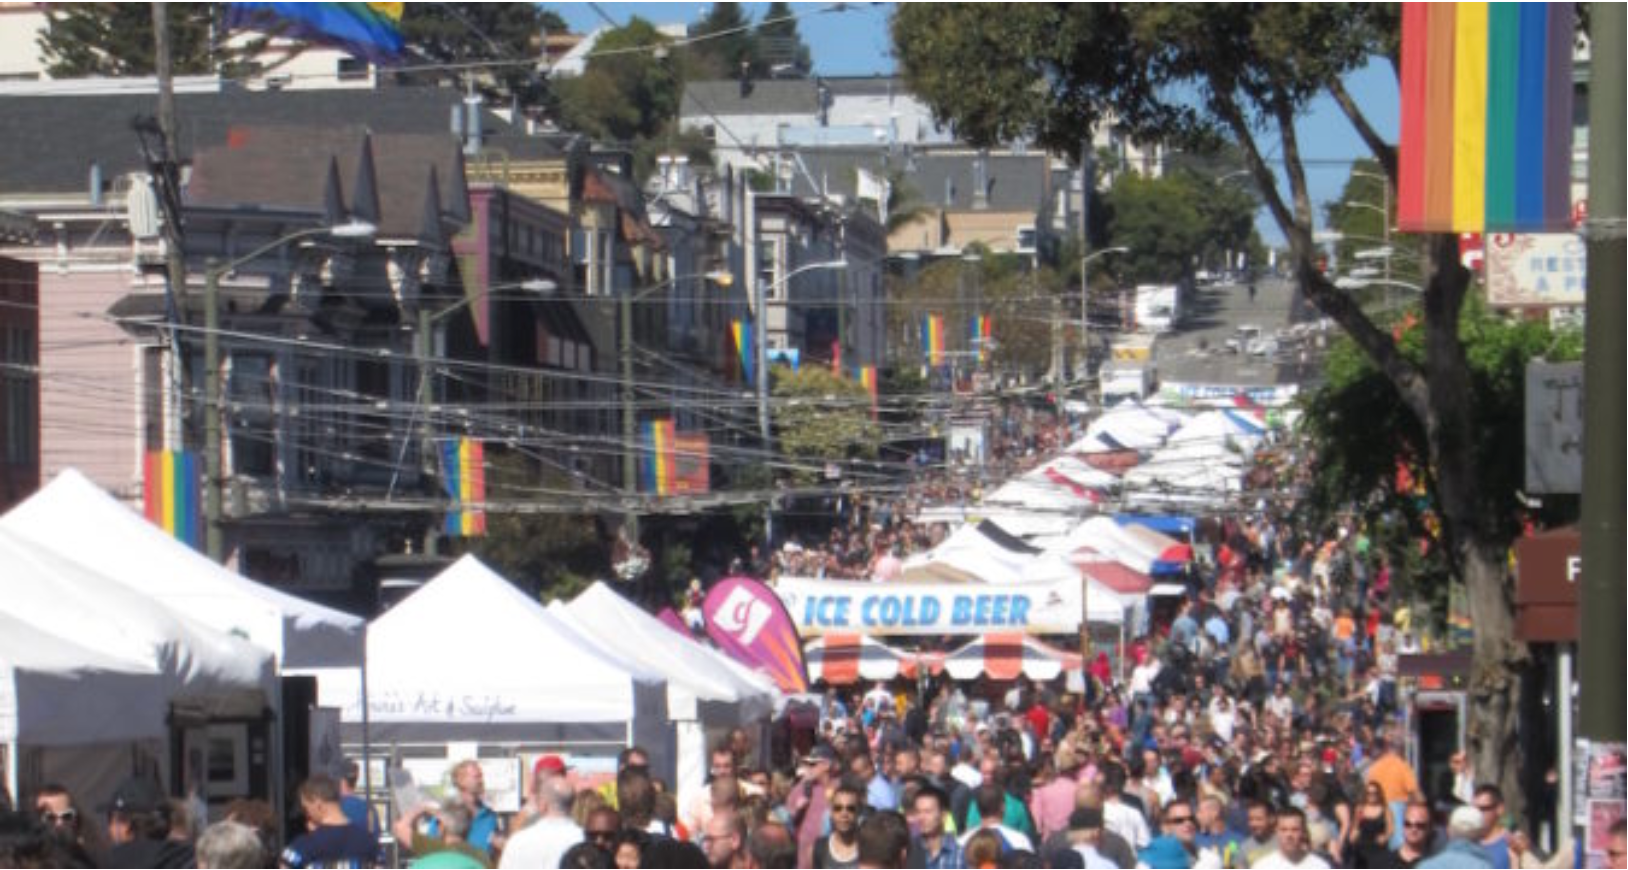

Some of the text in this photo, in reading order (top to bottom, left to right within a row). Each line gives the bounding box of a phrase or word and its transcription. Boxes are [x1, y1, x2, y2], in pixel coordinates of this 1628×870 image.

[803, 594, 853, 627] ICE
[860, 595, 941, 627] COLD
[950, 594, 1032, 626] BEER
